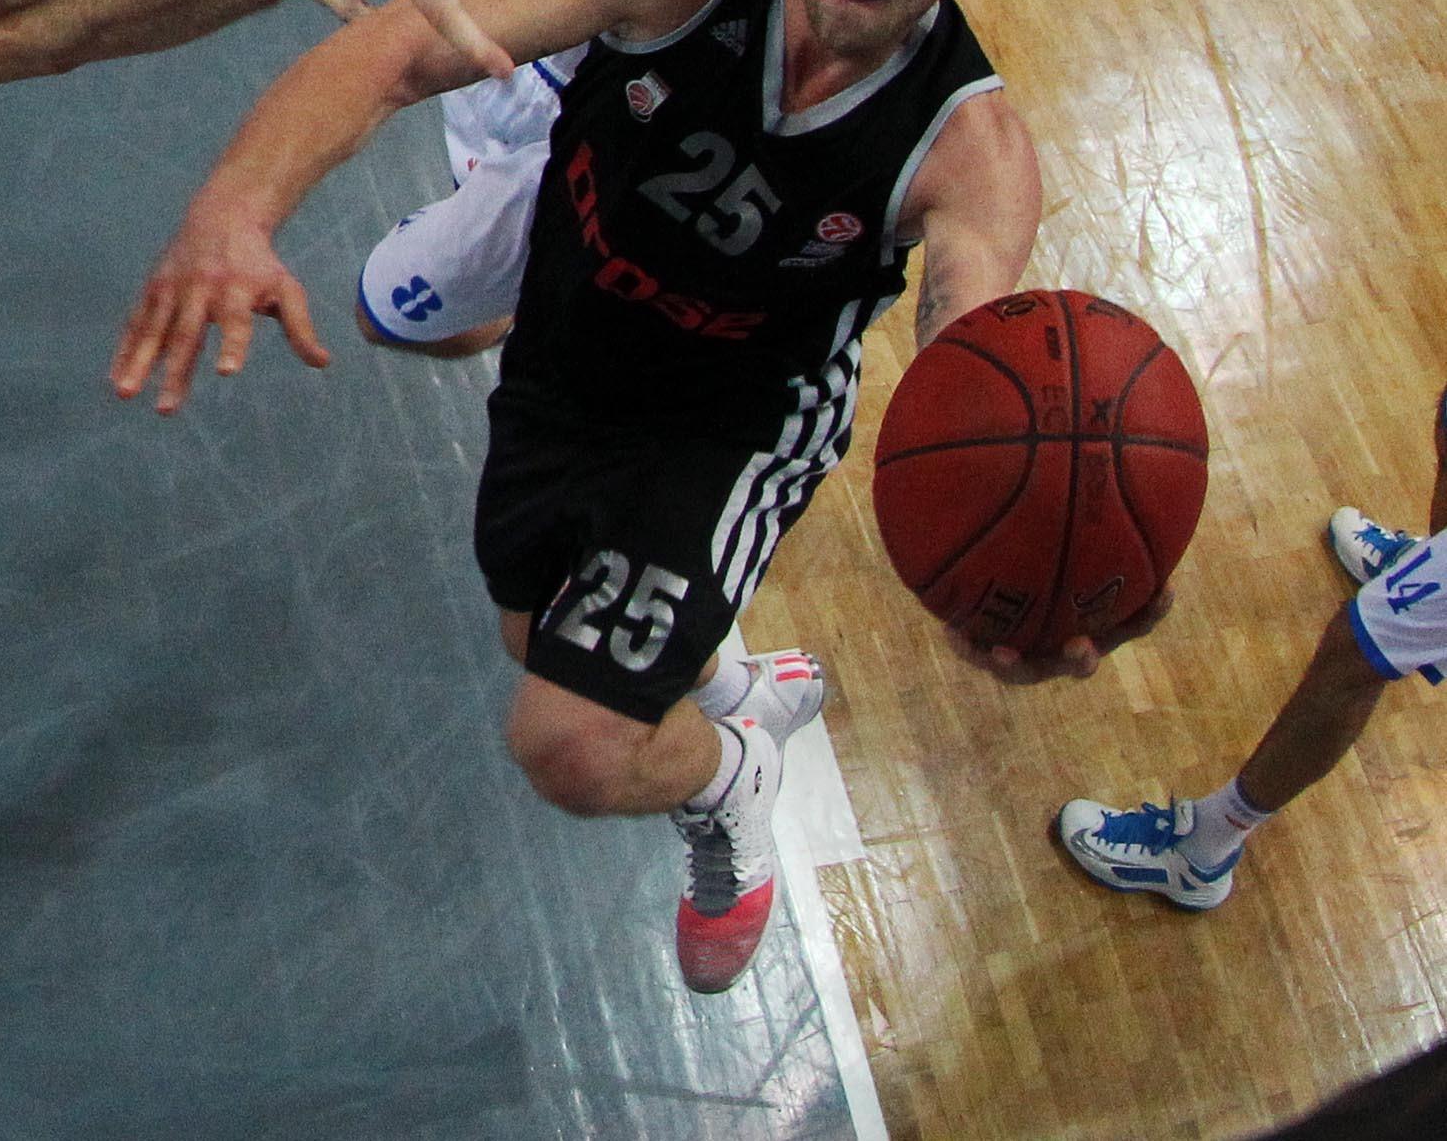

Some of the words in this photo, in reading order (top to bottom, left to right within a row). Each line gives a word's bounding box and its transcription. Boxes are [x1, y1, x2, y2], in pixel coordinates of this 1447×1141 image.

[566, 140, 768, 340] brose
[637, 130, 783, 256] 25
[391, 274, 443, 322] 8
[556, 548, 691, 673] 25
